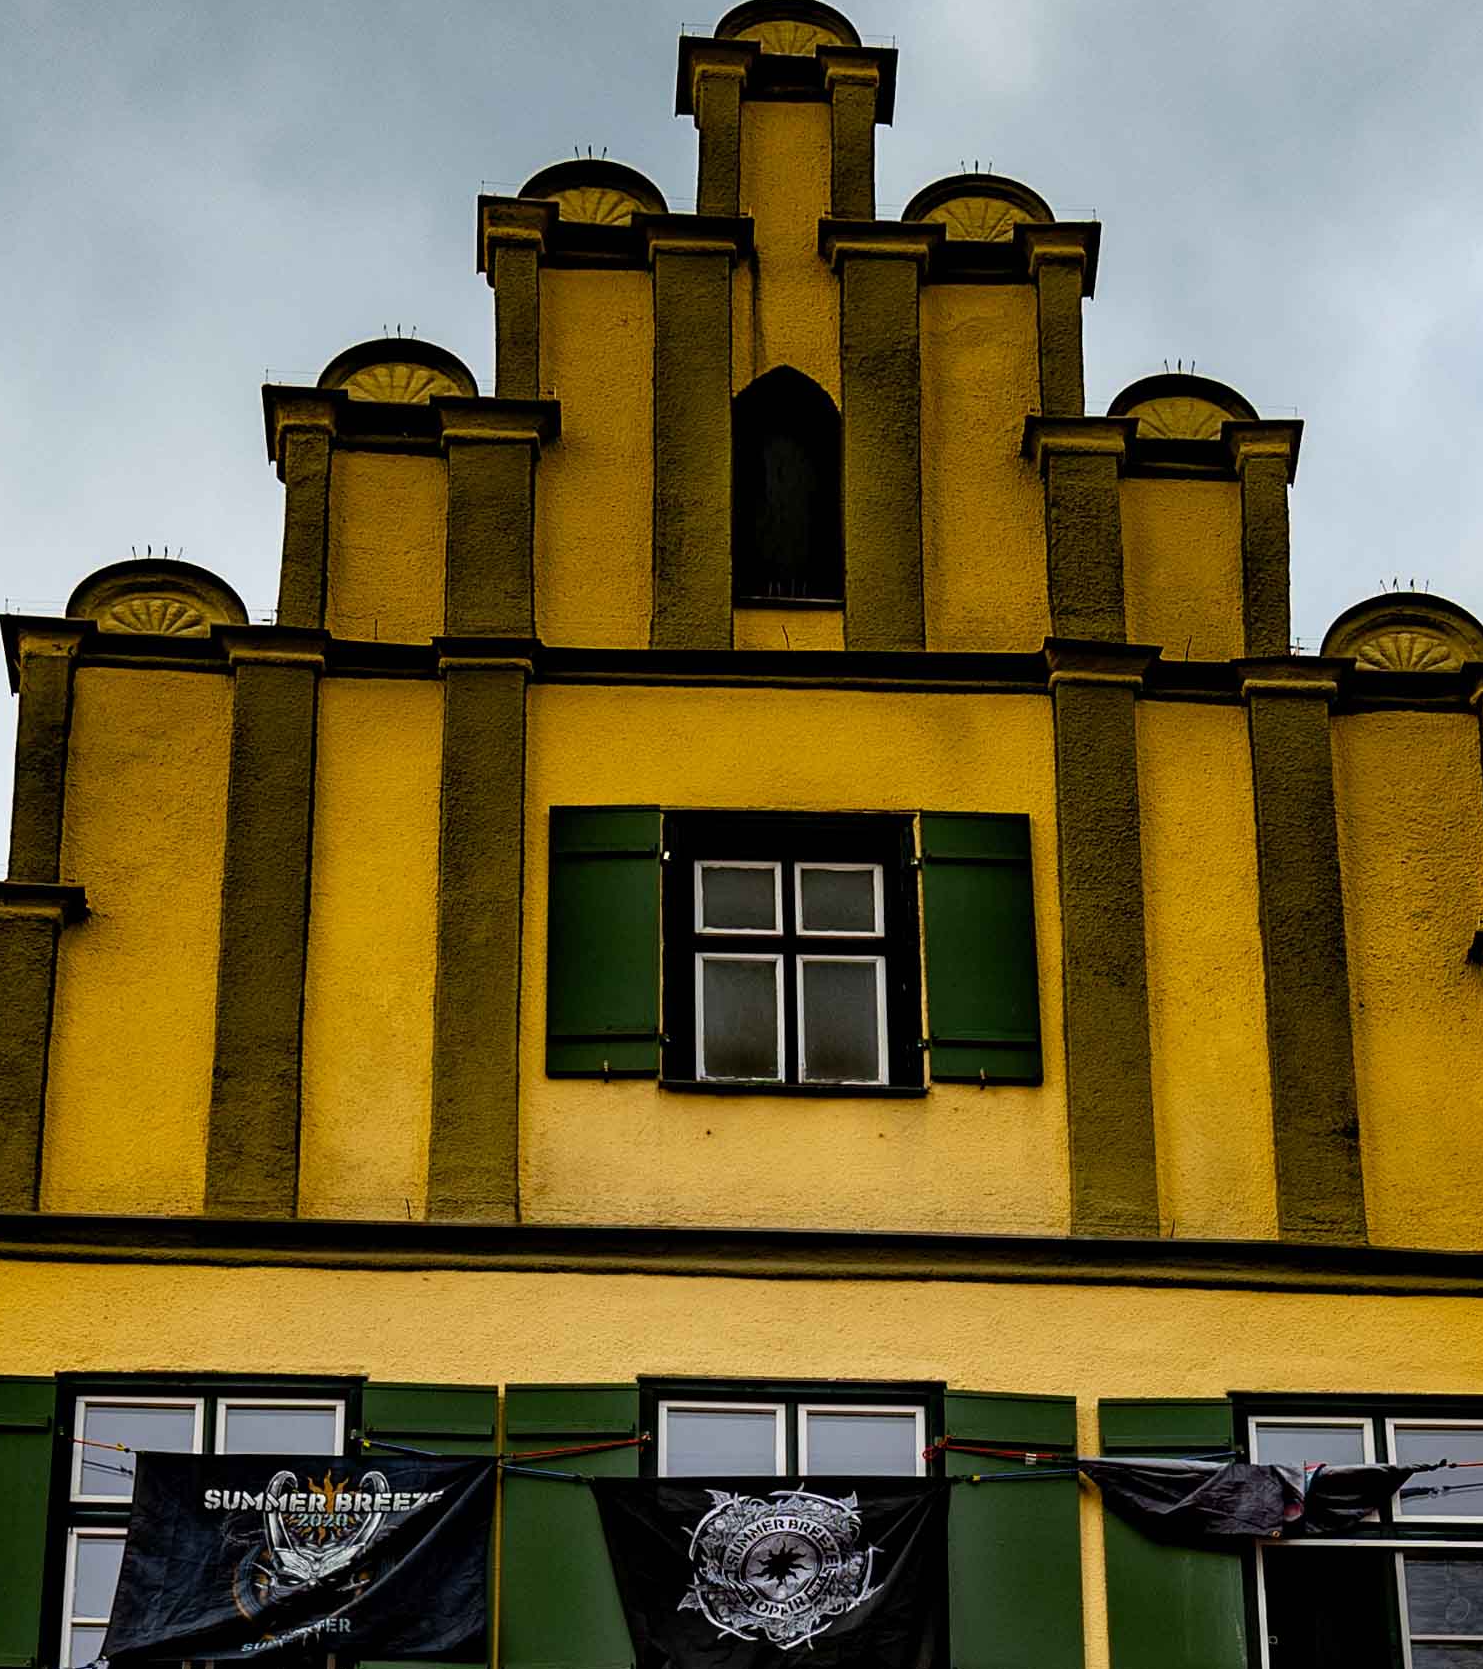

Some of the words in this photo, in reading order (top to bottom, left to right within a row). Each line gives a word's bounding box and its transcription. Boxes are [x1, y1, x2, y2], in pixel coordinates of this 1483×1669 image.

[204, 1489, 327, 1513] SUMMER
[298, 1513, 349, 1528] 2020
[726, 1518, 785, 1566] SUMMER
